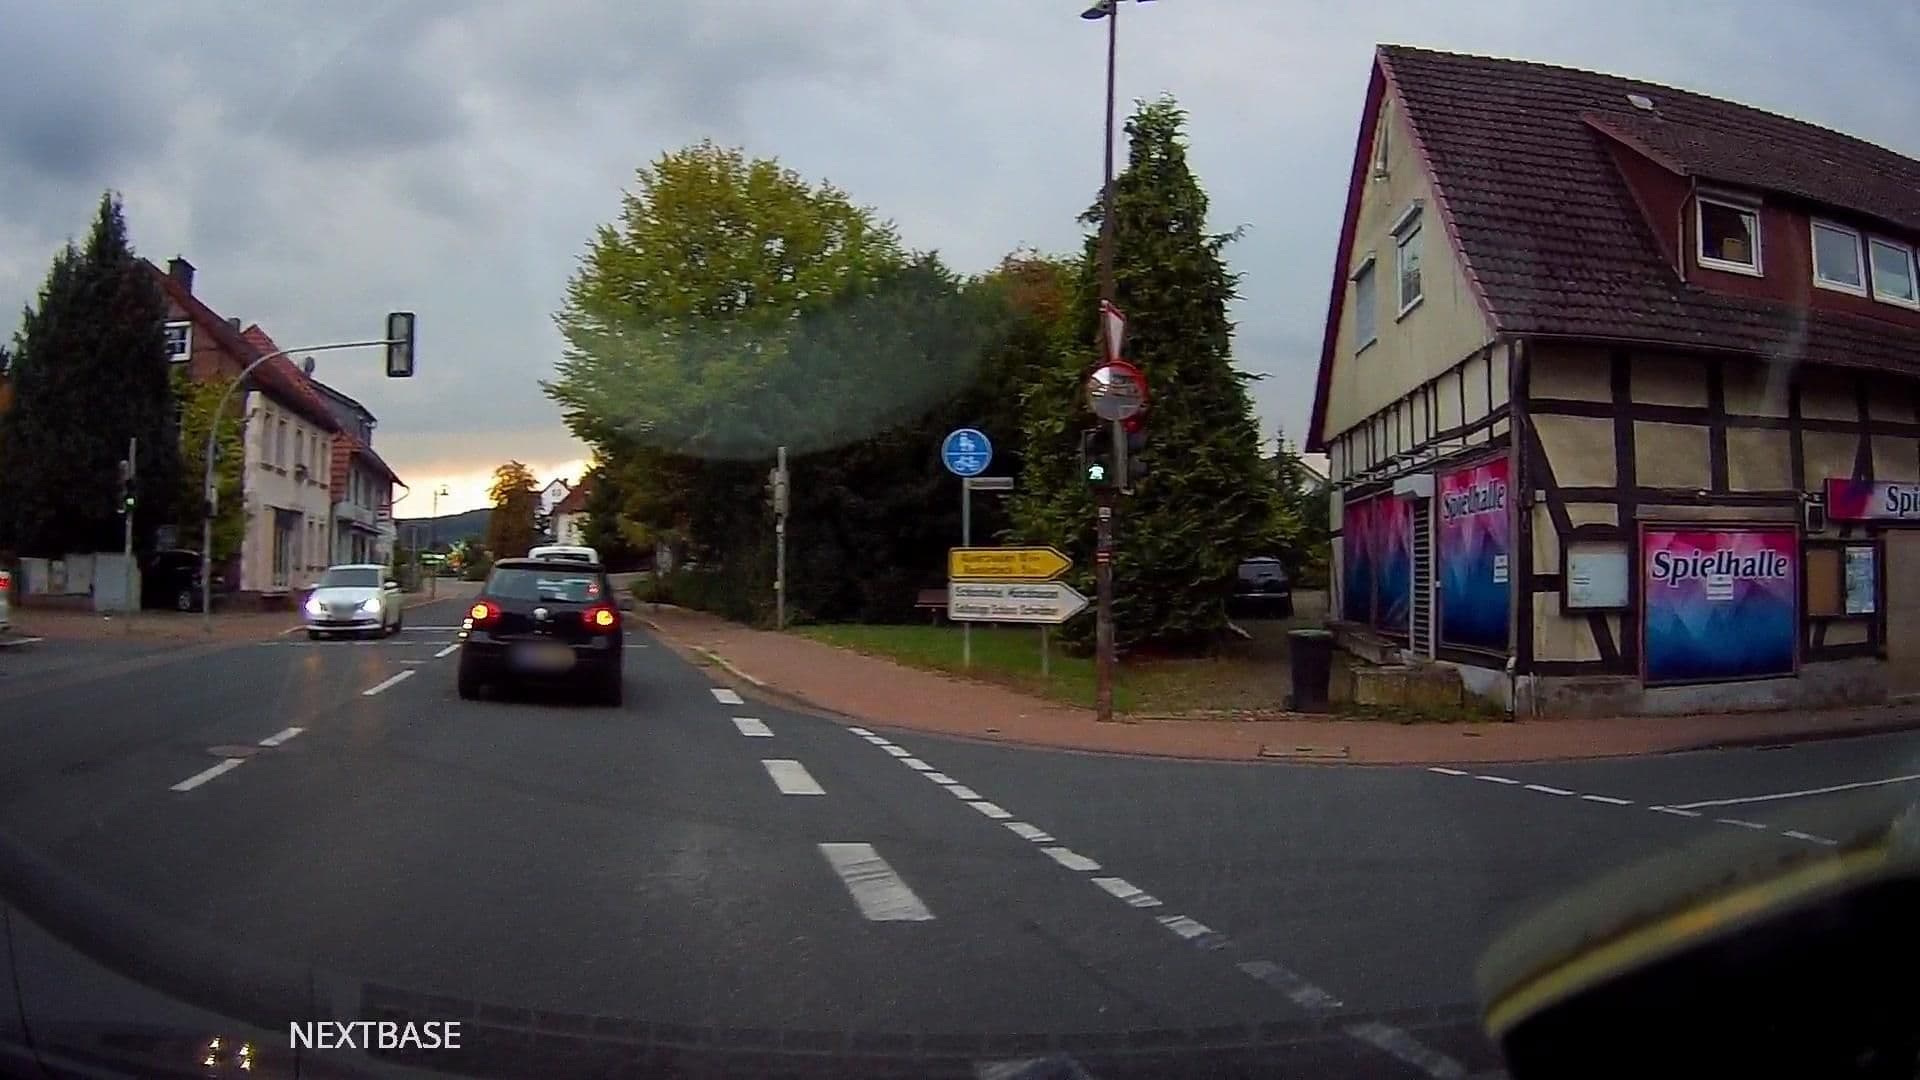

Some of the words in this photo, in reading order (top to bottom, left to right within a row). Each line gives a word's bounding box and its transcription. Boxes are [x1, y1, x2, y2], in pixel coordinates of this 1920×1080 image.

[1443, 480, 1505, 526] Spielhalle
[1886, 485, 1920, 518] Spi
[1652, 550, 1788, 586] Spielhalle
